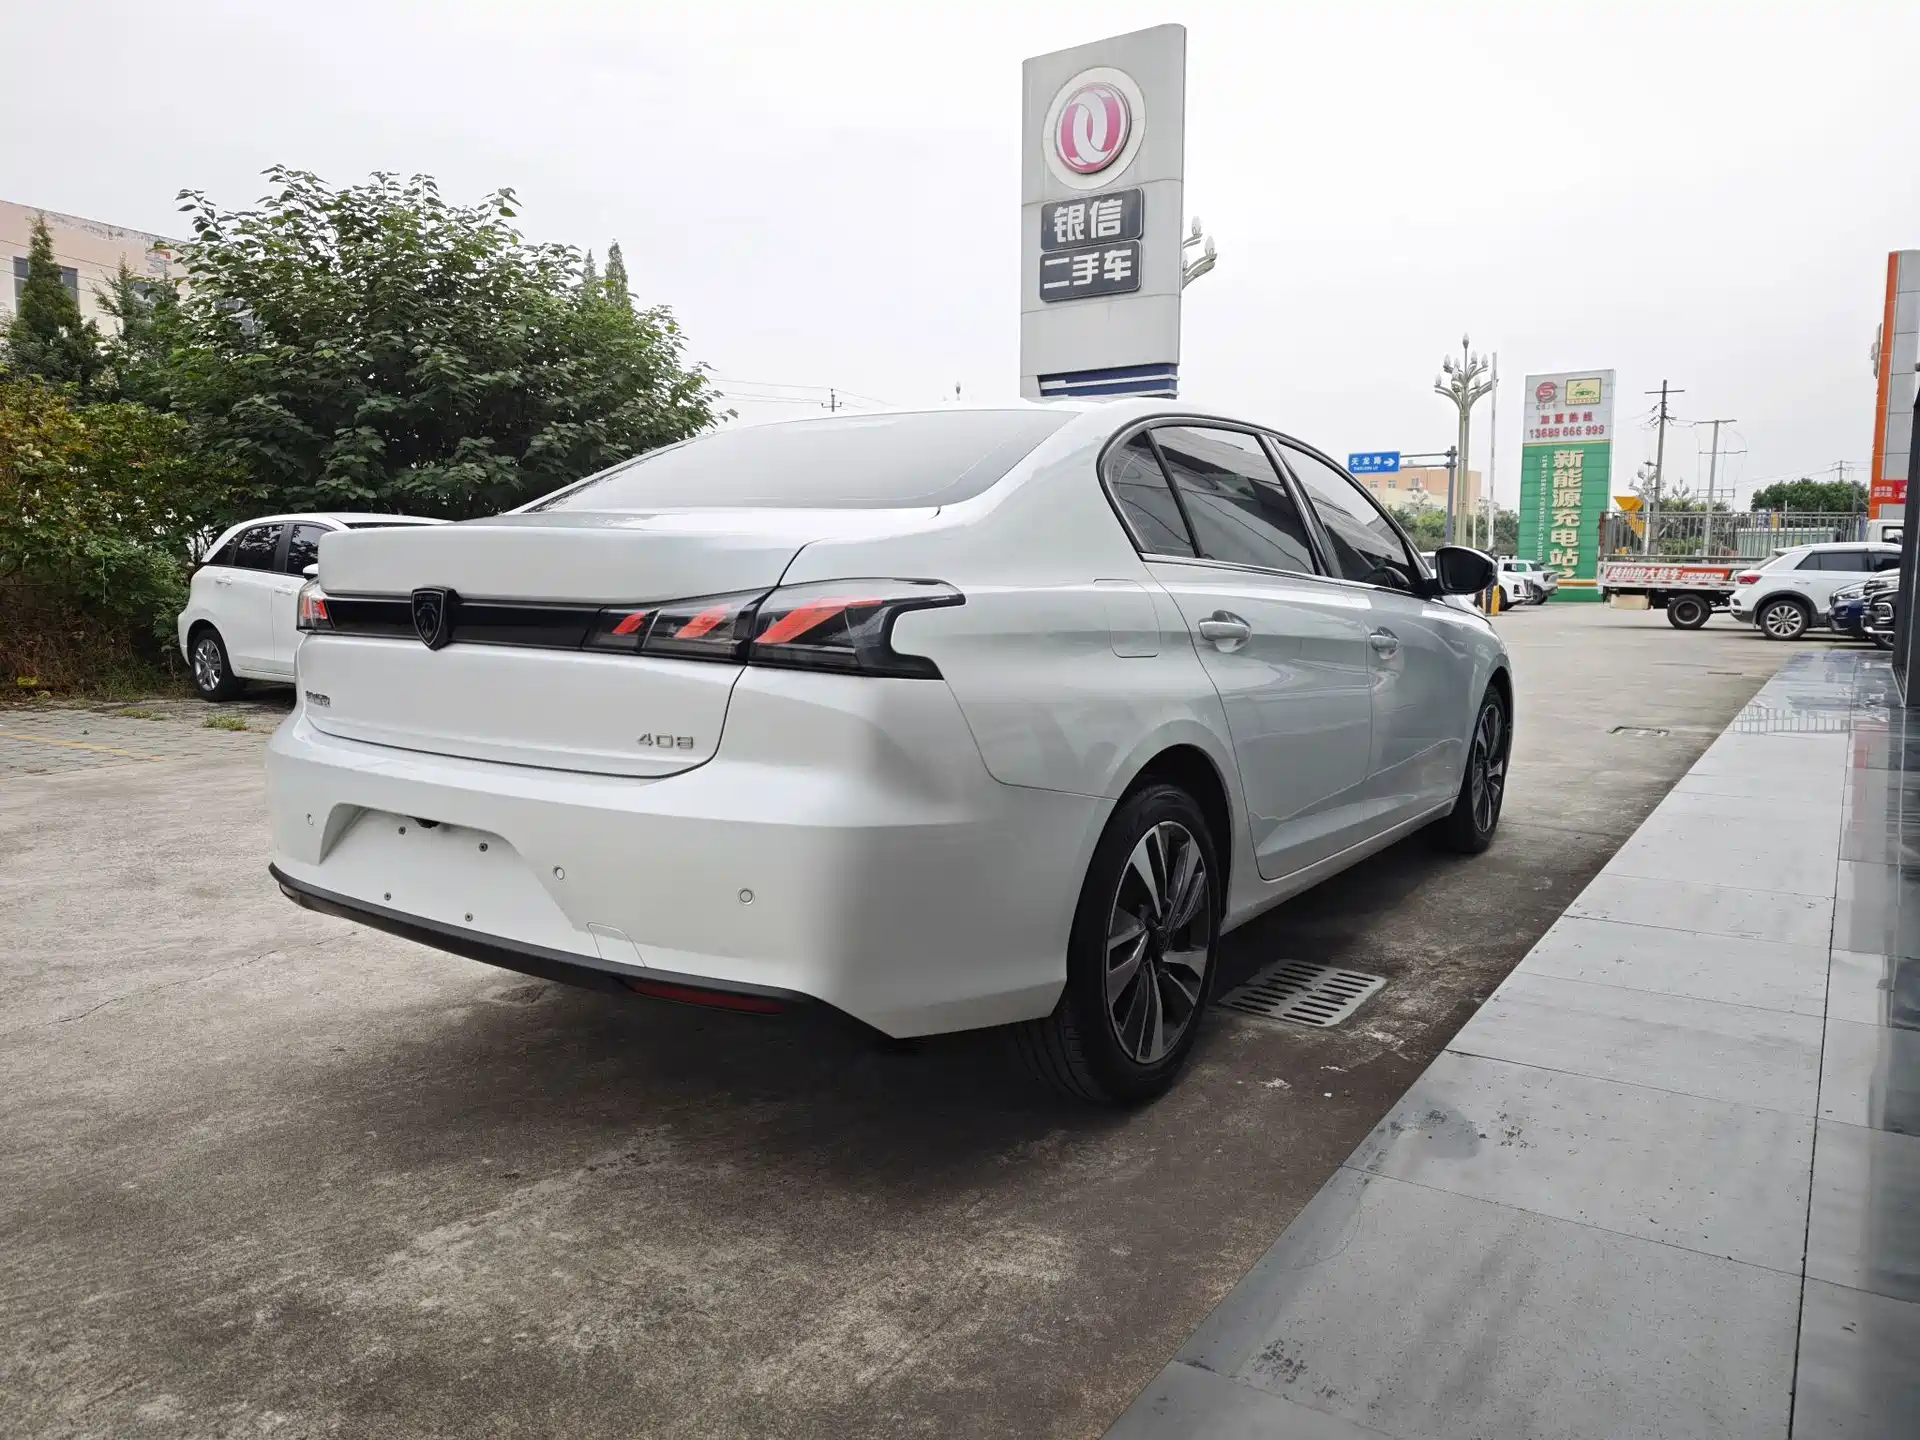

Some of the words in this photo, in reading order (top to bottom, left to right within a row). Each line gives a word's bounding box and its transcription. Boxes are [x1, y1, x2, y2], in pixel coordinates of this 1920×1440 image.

[1054, 199, 1123, 243] 银信
[1044, 249, 1132, 290] 二手车
[1529, 428, 1560, 439] 13689
[1562, 426, 1582, 437] 666
[1585, 424, 1605, 436] 999
[1549, 449, 1584, 568] 新能源充电站
[637, 732, 694, 749] 408
